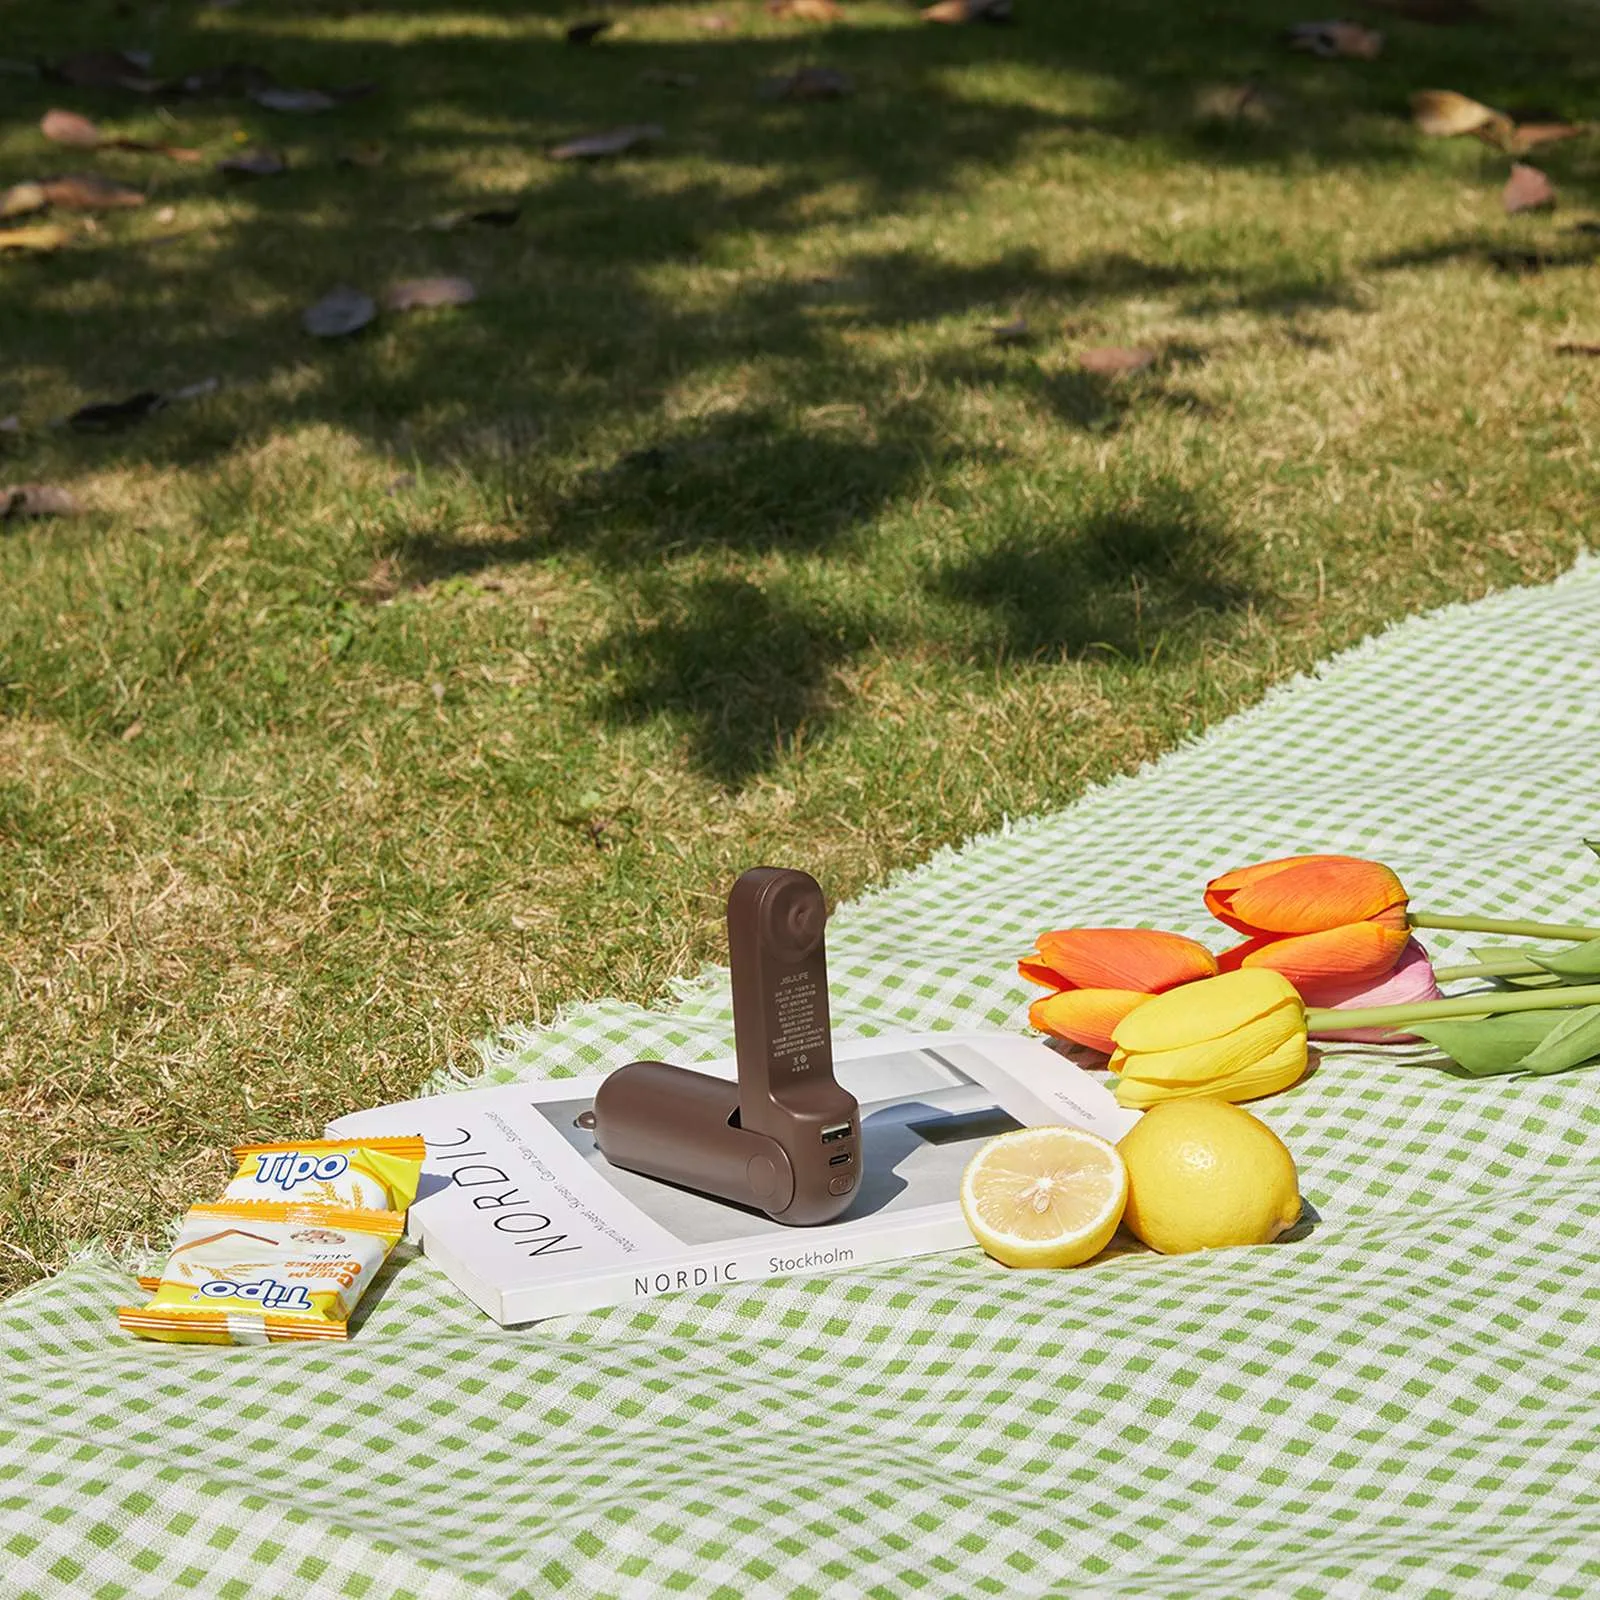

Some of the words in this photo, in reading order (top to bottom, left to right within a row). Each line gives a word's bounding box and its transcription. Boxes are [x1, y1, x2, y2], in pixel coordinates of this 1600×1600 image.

[256, 1151, 348, 1190] Tipo
[425, 1127, 583, 1257] NORDIC
[634, 1262, 738, 1295] NORDIC
[769, 1247, 854, 1273] Stockholm
[201, 1279, 312, 1309] Tipo
